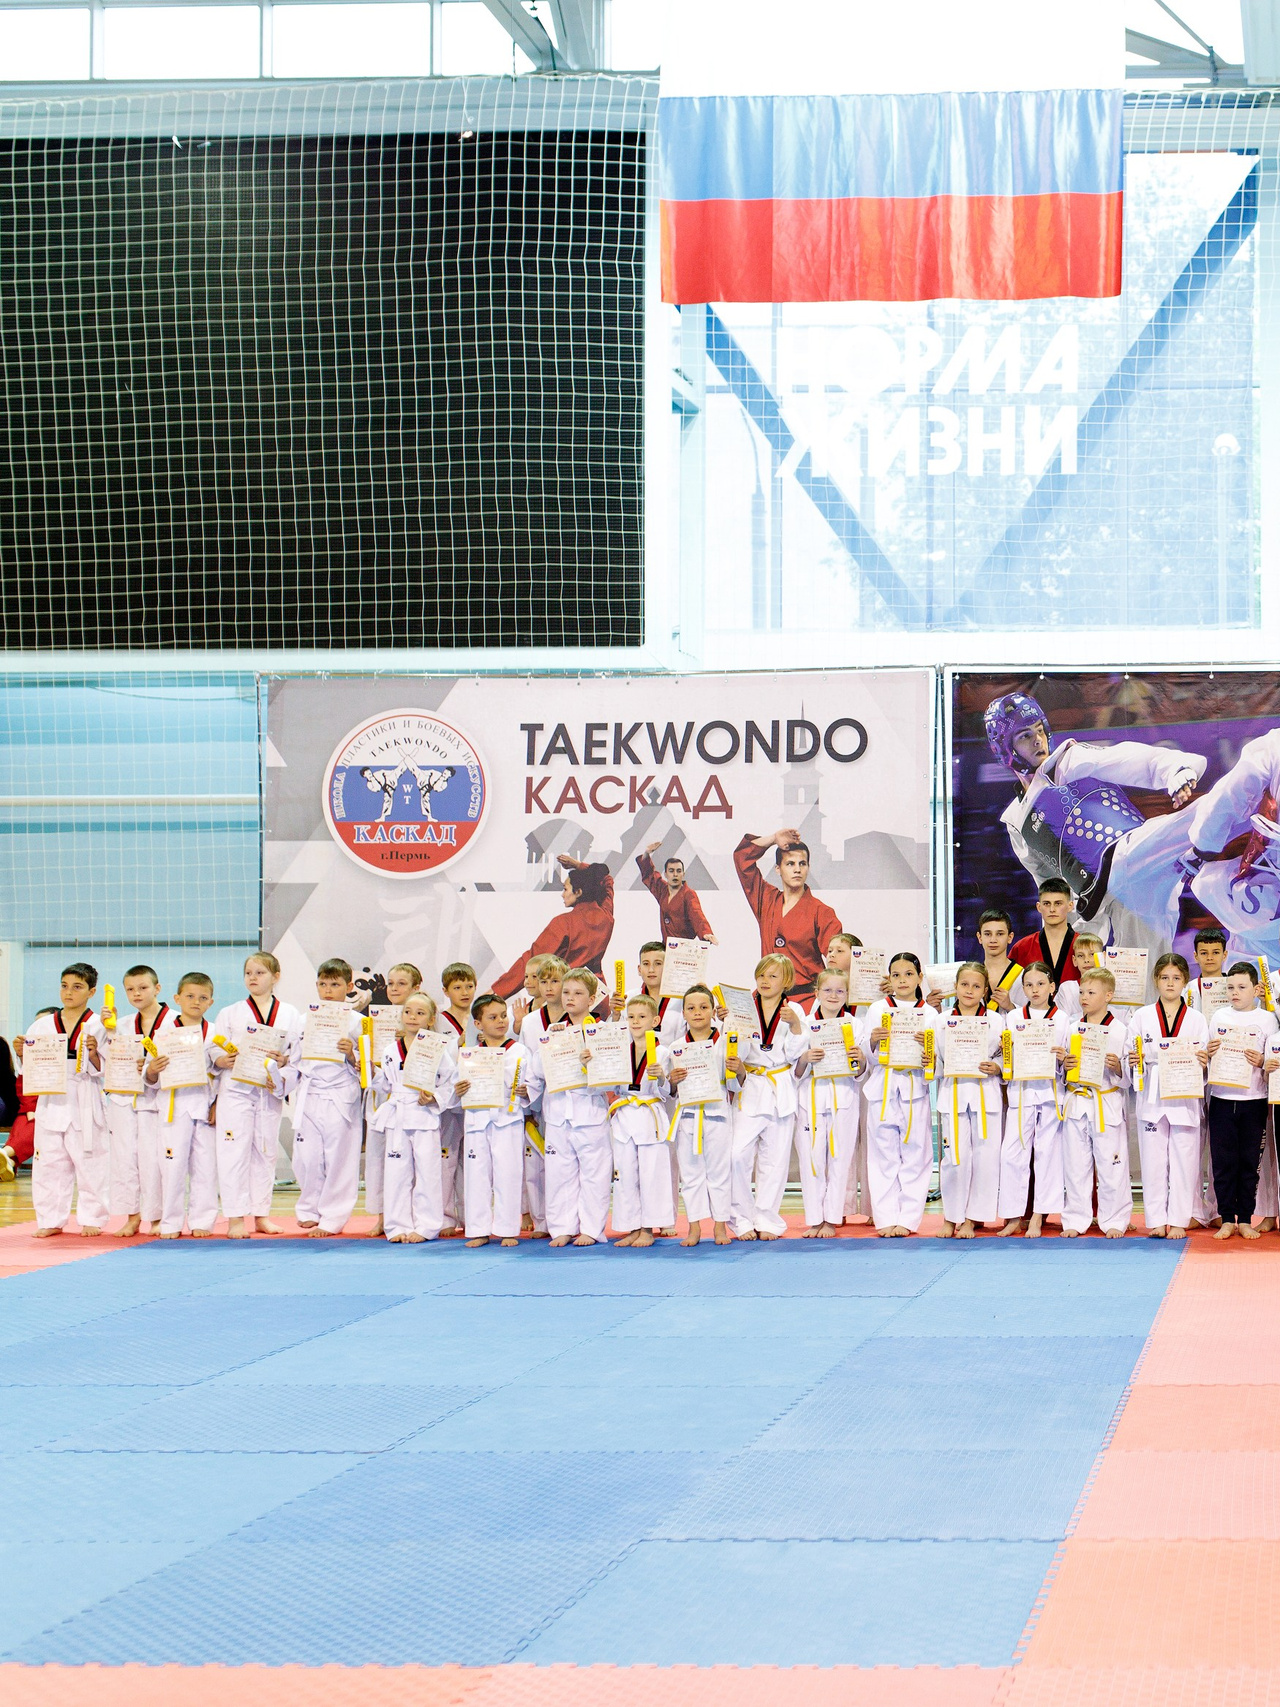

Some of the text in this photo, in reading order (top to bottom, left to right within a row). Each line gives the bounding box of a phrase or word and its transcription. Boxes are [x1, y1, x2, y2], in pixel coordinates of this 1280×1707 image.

[776, 325, 1078, 396] НОРМА
[775, 405, 1078, 477] ЖИЗНИ
[341, 720, 397, 769] ПЛАСТИКИ
[403, 720, 411, 728] И
[417, 720, 464, 750] БОЕВЫХ
[369, 737, 449, 760] TAEKWONDO
[520, 717, 868, 766] TAEKWONDO
[524, 774, 733, 820] КАСКАД
[354, 824, 457, 846] КАСКАД
[380, 851, 431, 862] г.Пермь
